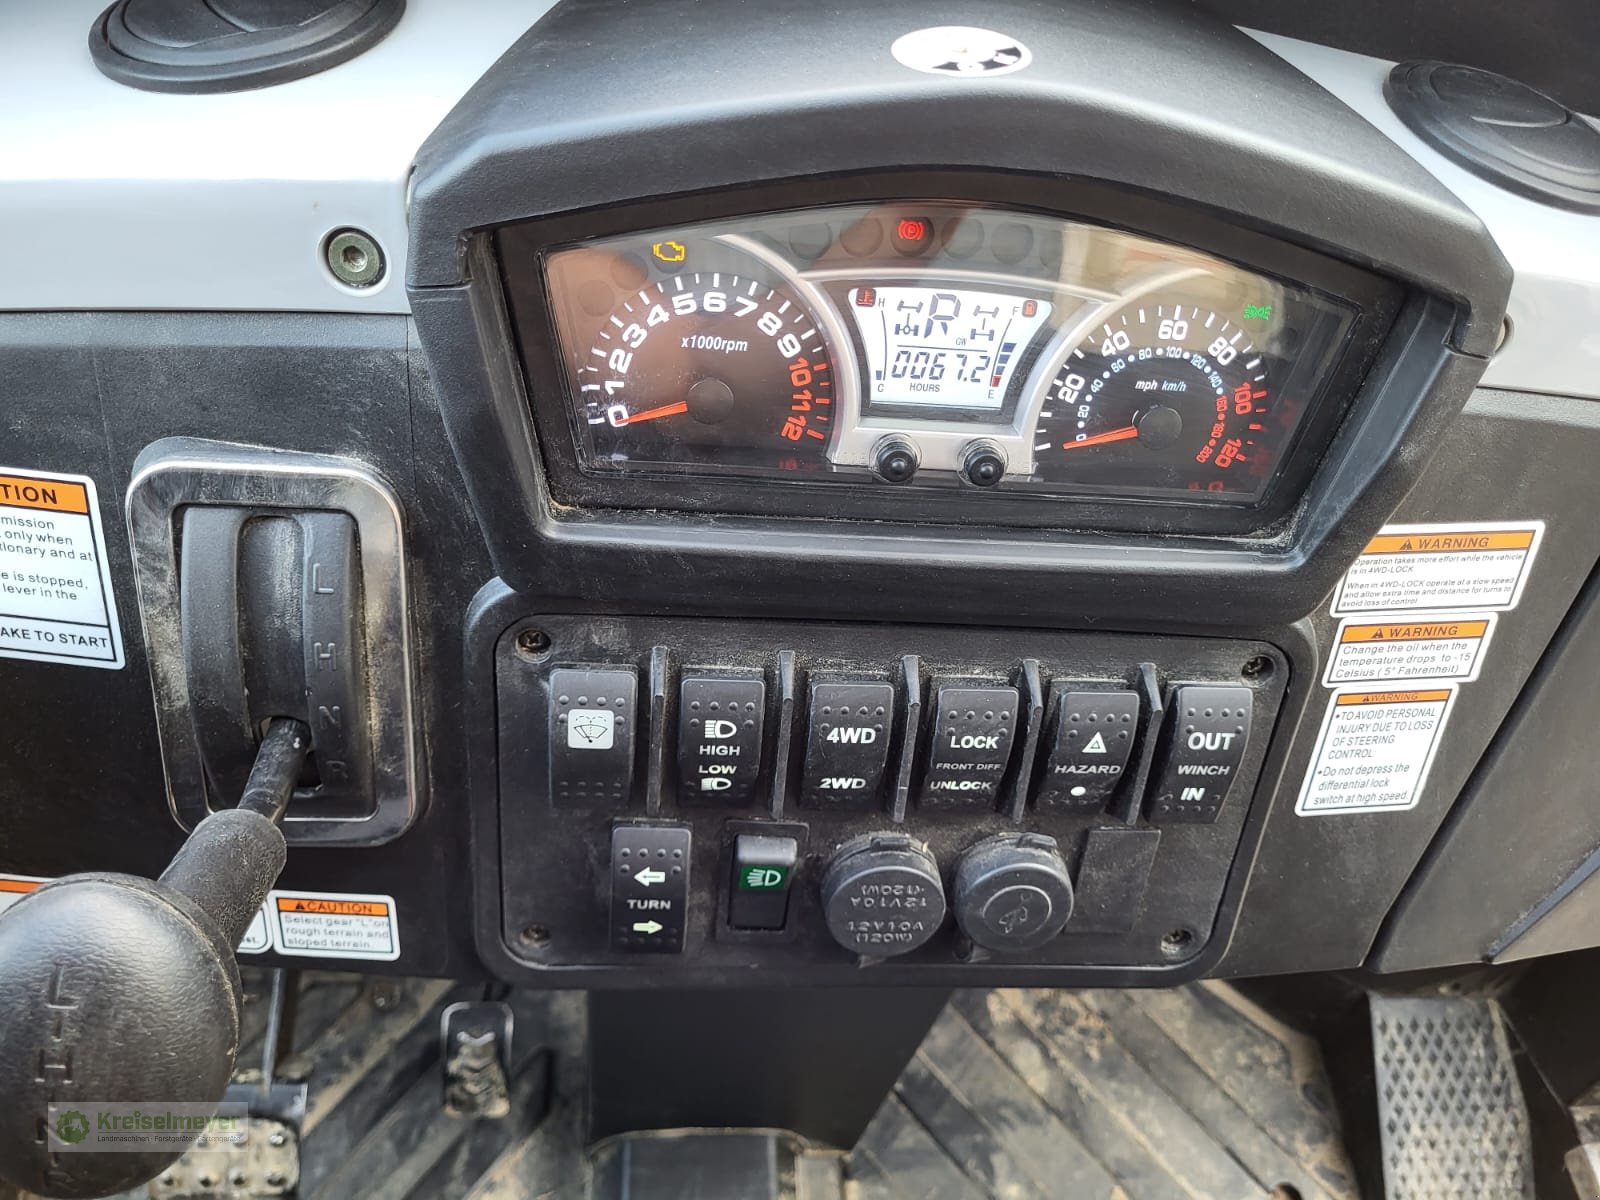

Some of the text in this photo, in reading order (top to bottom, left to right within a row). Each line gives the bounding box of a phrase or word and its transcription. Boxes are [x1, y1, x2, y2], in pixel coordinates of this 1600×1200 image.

[672, 293, 697, 316] 5
[703, 292, 727, 312] 6
[733, 296, 759, 317] 7
[878, 298, 885, 307] H
[647, 304, 670, 327] 4
[1012, 306, 1020, 316] F
[757, 311, 783, 337] 8
[1158, 320, 1188, 340] 60
[622, 323, 648, 349] 3
[681, 335, 748, 354] x1000rpm
[777, 333, 801, 358] 9
[1100, 331, 1130, 358] 40
[1207, 337, 1236, 366] 80
[1166, 346, 1182, 358] 100
[609, 348, 633, 374] 2
[891, 350, 991, 383] 0067.2
[789, 357, 812, 386] 10
[604, 380, 625, 395] 1
[877, 383, 885, 392] C
[909, 383, 940, 393] HOURS
[1058, 374, 1085, 404] 20
[1091, 378, 1104, 393] 40
[1135, 380, 1187, 392] mph km/h
[791, 389, 813, 411] 11
[988, 389, 995, 399] E
[1234, 382, 1252, 415] 100
[607, 404, 629, 427] 0
[1077, 405, 1090, 418] 20
[781, 416, 807, 441] 12
[1215, 439, 1242, 468] 120
[1, 516, 55, 529] mission
[5, 530, 33, 543] only
[36, 534, 73, 546] when
[1418, 537, 1489, 549] WARNING
[50, 549, 75, 560] and
[80, 551, 93, 562] at
[1394, 557, 1415, 565] takes
[13, 571, 25, 582] is
[1368, 566, 1414, 574] 4WD-LOCK
[313, 563, 334, 594] L
[3, 584, 78, 601] lever in the
[1341, 600, 1363, 608] avoid
[1381, 598, 1390, 606] of
[0, 627, 108, 649] AKE TO START
[1389, 626, 1459, 637] WARNING
[1343, 641, 1468, 655] Change the oil when the
[313, 642, 337, 672] H
[1339, 653, 1451, 667] temperature drops to
[1336, 665, 1459, 679] Celsius Fahrenheit)
[1370, 692, 1418, 702] WARNING
[318, 705, 341, 730] N
[1354, 709, 1384, 720] AVOID
[1385, 707, 1436, 719] PERSONAL
[1336, 720, 1433, 734] INJURY DUE TO LOSS
[826, 727, 877, 744] 4WD
[950, 735, 999, 750] LOCK
[1187, 732, 1236, 751] OUT
[1332, 735, 1395, 747] OF STEERING
[699, 745, 741, 756] HIGH
[699, 764, 737, 775] LOW
[935, 762, 1001, 771] FRONT DIFF
[1054, 765, 1121, 775] HAZARD
[1177, 765, 1231, 776] WINCH
[1338, 765, 1353, 776] not
[1355, 764, 1393, 776] depress
[1395, 763, 1410, 773] the
[819, 777, 867, 790] 2WD
[930, 781, 992, 792] UNLOCK
[1318, 778, 1389, 791] differential lock
[1180, 787, 1206, 801] IN
[1314, 794, 1345, 805] switch
[1346, 794, 1355, 803] at
[1356, 792, 1377, 804] high
[306, 901, 373, 913] CAUTION
[627, 899, 672, 910] TURN
[284, 915, 323, 926] Select
[326, 917, 352, 928] gear
[285, 928, 390, 940] rough terrain and
[287, 938, 371, 950] sloped terrain
